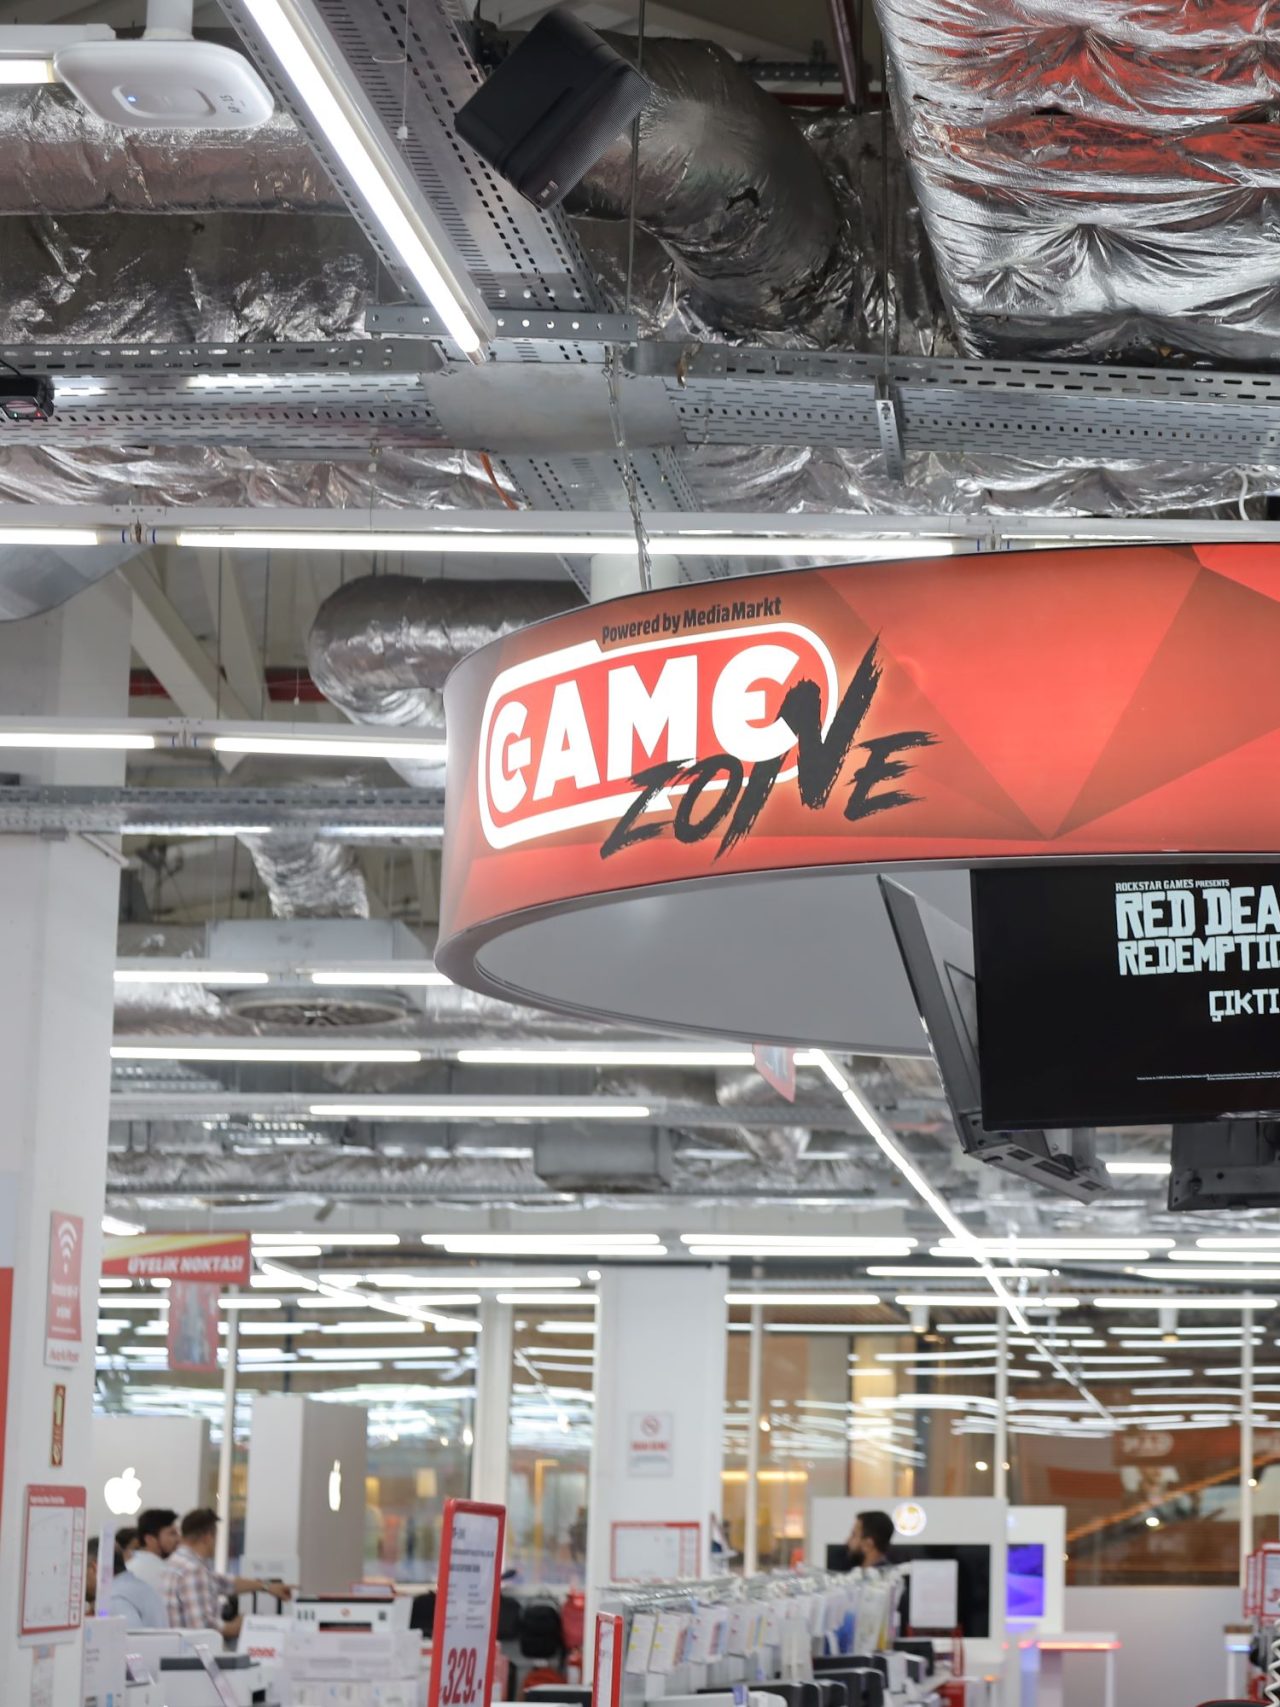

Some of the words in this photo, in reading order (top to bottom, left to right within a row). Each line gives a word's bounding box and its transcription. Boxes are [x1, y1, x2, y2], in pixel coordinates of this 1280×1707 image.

[602, 614, 660, 645] Powered
[662, 611, 681, 634] by
[683, 596, 782, 629] MediaMarkt
[489, 644, 801, 813] GAME
[600, 627, 944, 866] ZONE
[1115, 880, 1162, 892] ROCKSTAR
[1163, 879, 1194, 890] GAMES
[1195, 879, 1230, 888] PRESENTS
[1115, 889, 1196, 939] RED
[1209, 988, 1280, 1022] ÇIKTI
